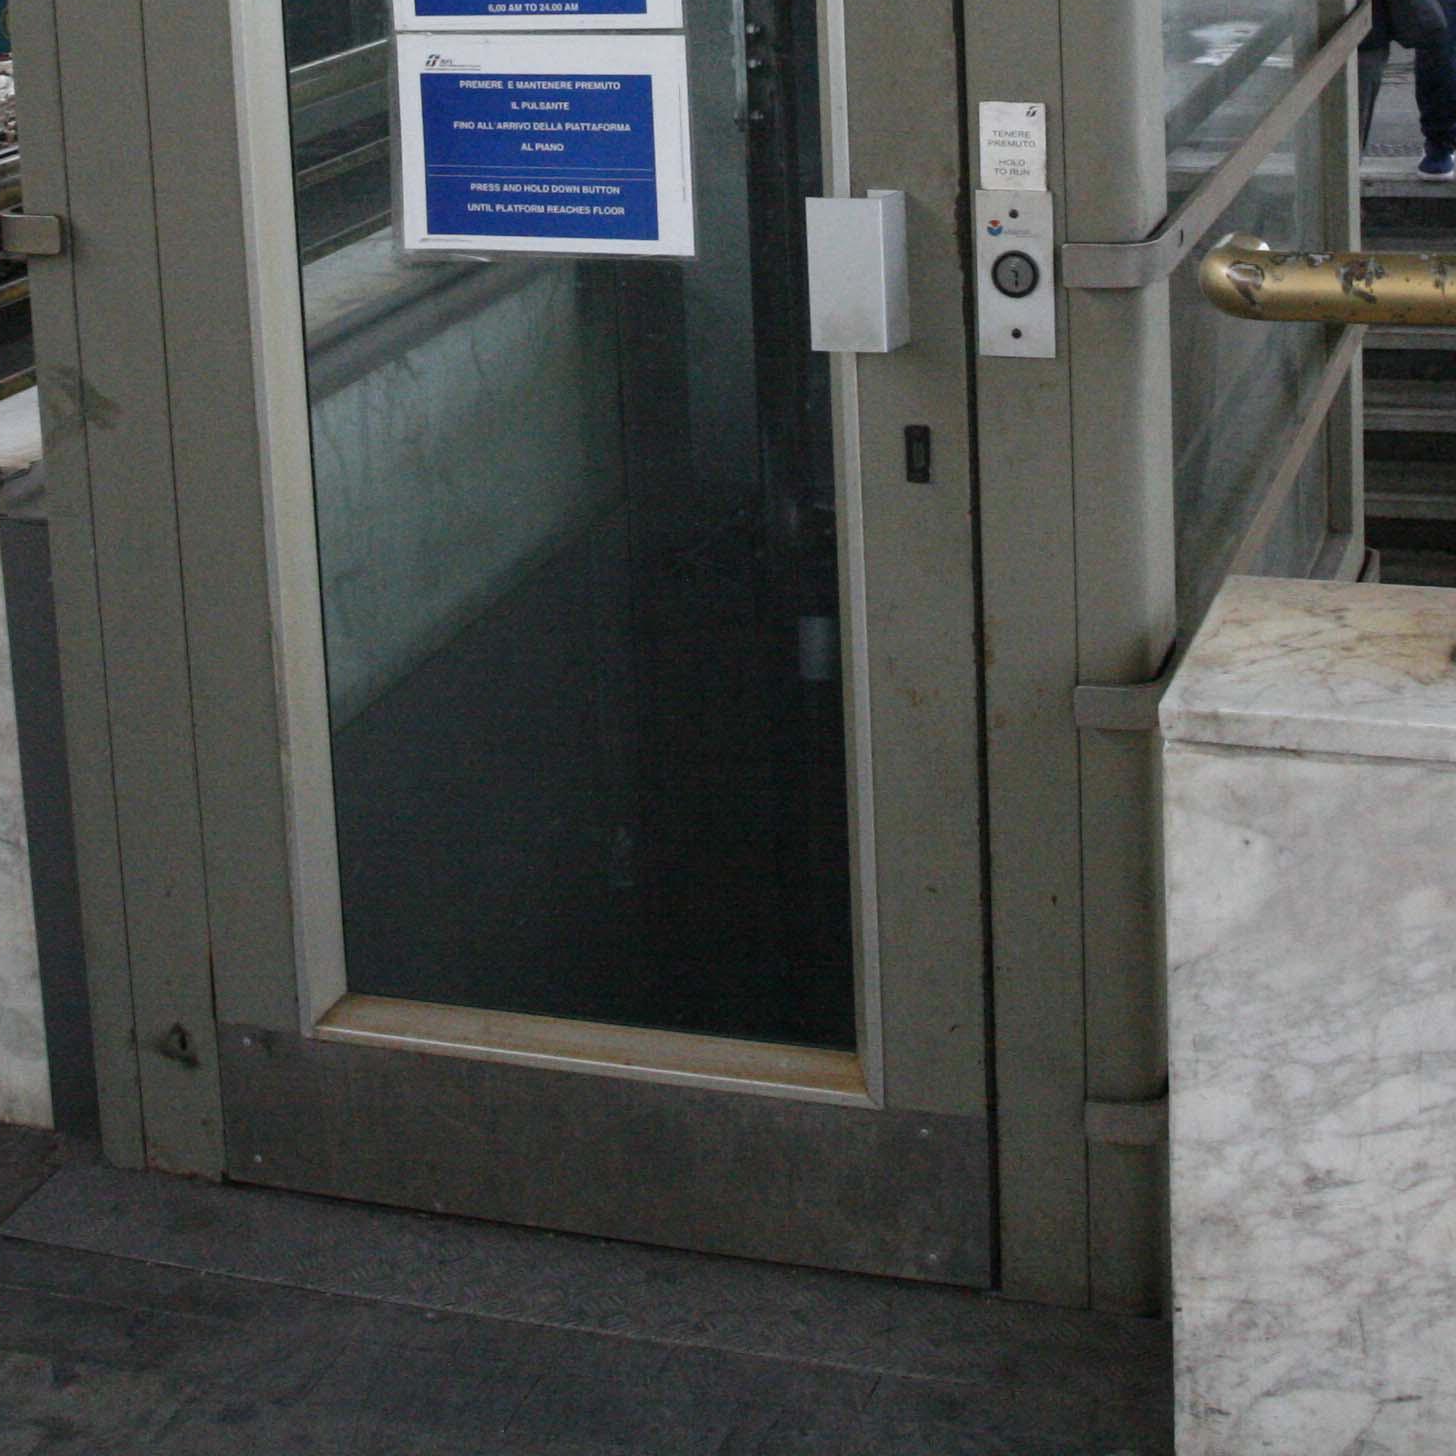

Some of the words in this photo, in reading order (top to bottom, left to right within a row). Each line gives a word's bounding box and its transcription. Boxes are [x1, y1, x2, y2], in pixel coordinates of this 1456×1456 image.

[508, 3, 523, 12] AM
[524, 3, 538, 12] TO
[564, 2, 580, 11] AM
[459, 80, 503, 90] PREMERE
[507, 80, 514, 90] E
[516, 80, 573, 90] MANTENERE
[575, 80, 621, 90] PREMUTO
[511, 101, 520, 110] IL
[521, 101, 570, 111] PULSANTE
[453, 121, 475, 130] FINO
[533, 122, 564, 131] DELLA
[564, 122, 631, 132] PIATTAFORMA
[992, 129, 1032, 139] TENERE
[520, 142, 534, 152] AL
[535, 142, 564, 152] PIANO
[987, 139, 1037, 148] PREMUTO
[994, 168, 1007, 176] TO
[470, 183, 500, 192] PRESS
[502, 184, 522, 193] AND
[523, 184, 549, 193] HOLD
[551, 184, 581, 193] DOWN
[582, 185, 620, 195] BUTTON
[467, 203, 494, 213] UNTIL
[495, 204, 545, 213] PLATFORM
[546, 205, 591, 215] REACHES
[592, 206, 625, 215] FLOOR
